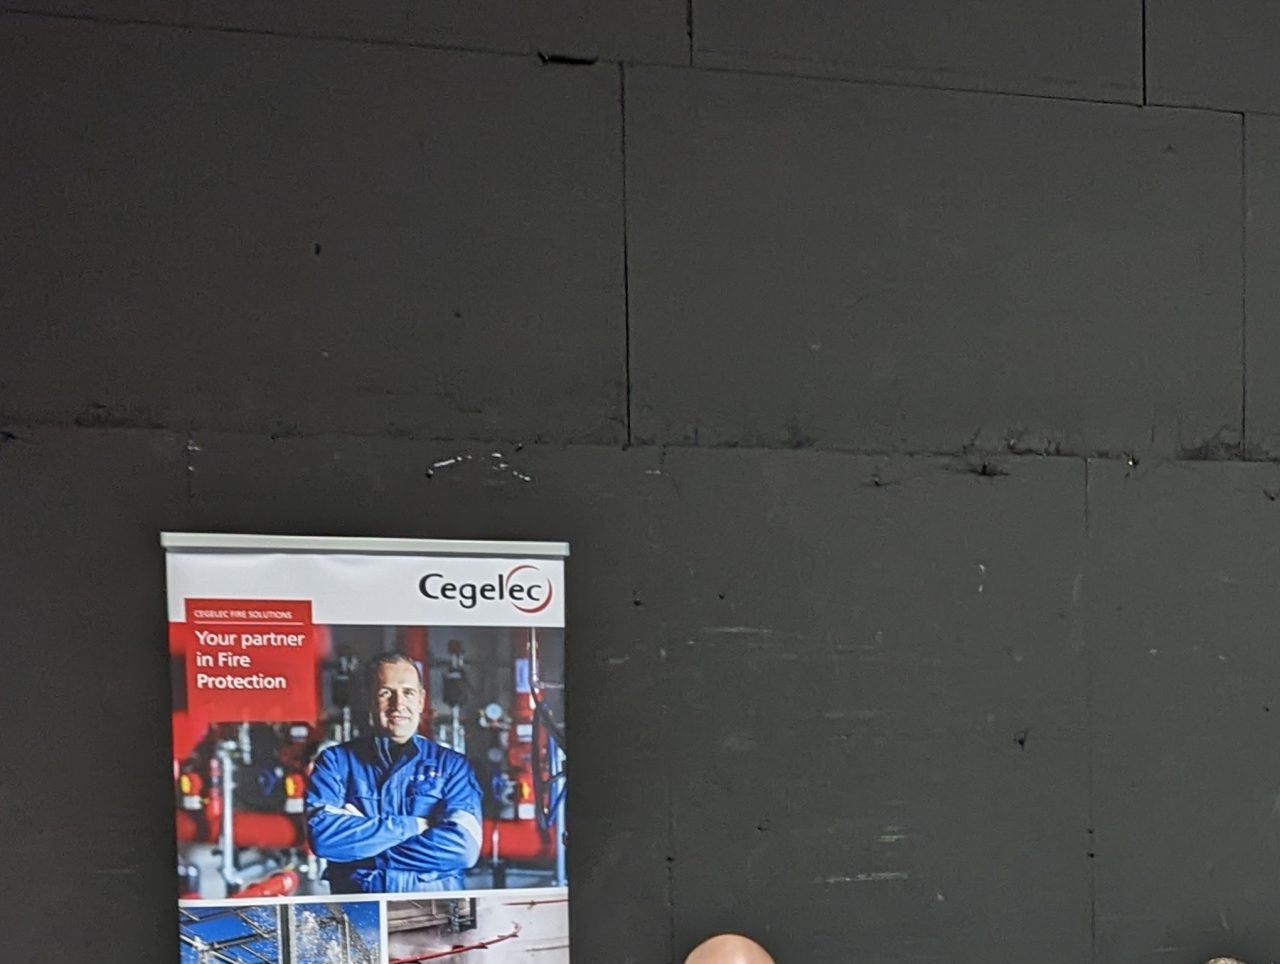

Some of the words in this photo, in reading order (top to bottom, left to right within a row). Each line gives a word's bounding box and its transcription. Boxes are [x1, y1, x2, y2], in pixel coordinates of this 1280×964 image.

[418, 573, 543, 609] Cegelec
[194, 630, 238, 646] Your
[241, 632, 306, 649] partner
[196, 651, 214, 667] in
[217, 651, 252, 668] Fire
[196, 672, 287, 689] Protection
